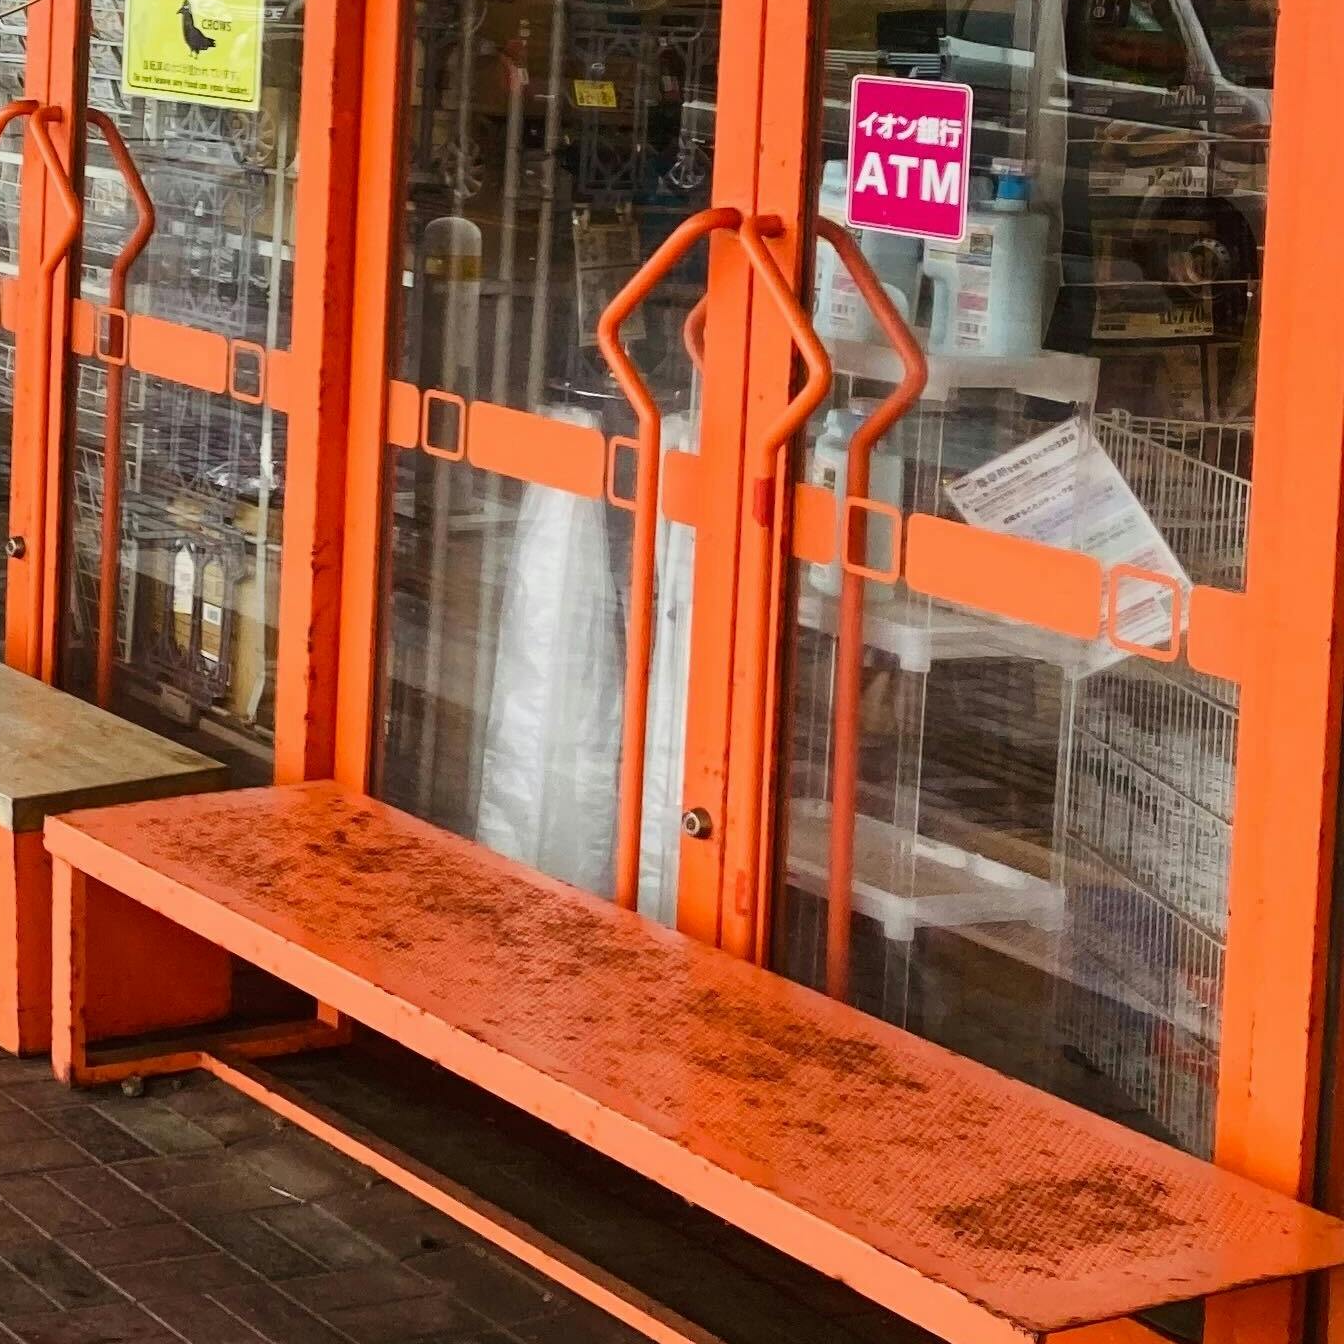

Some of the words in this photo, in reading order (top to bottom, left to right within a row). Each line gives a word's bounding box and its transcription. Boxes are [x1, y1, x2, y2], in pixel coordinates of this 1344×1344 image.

[201, 18, 233, 32] CROWS
[858, 111, 962, 149] イオン銀行
[854, 151, 961, 206] ATM
